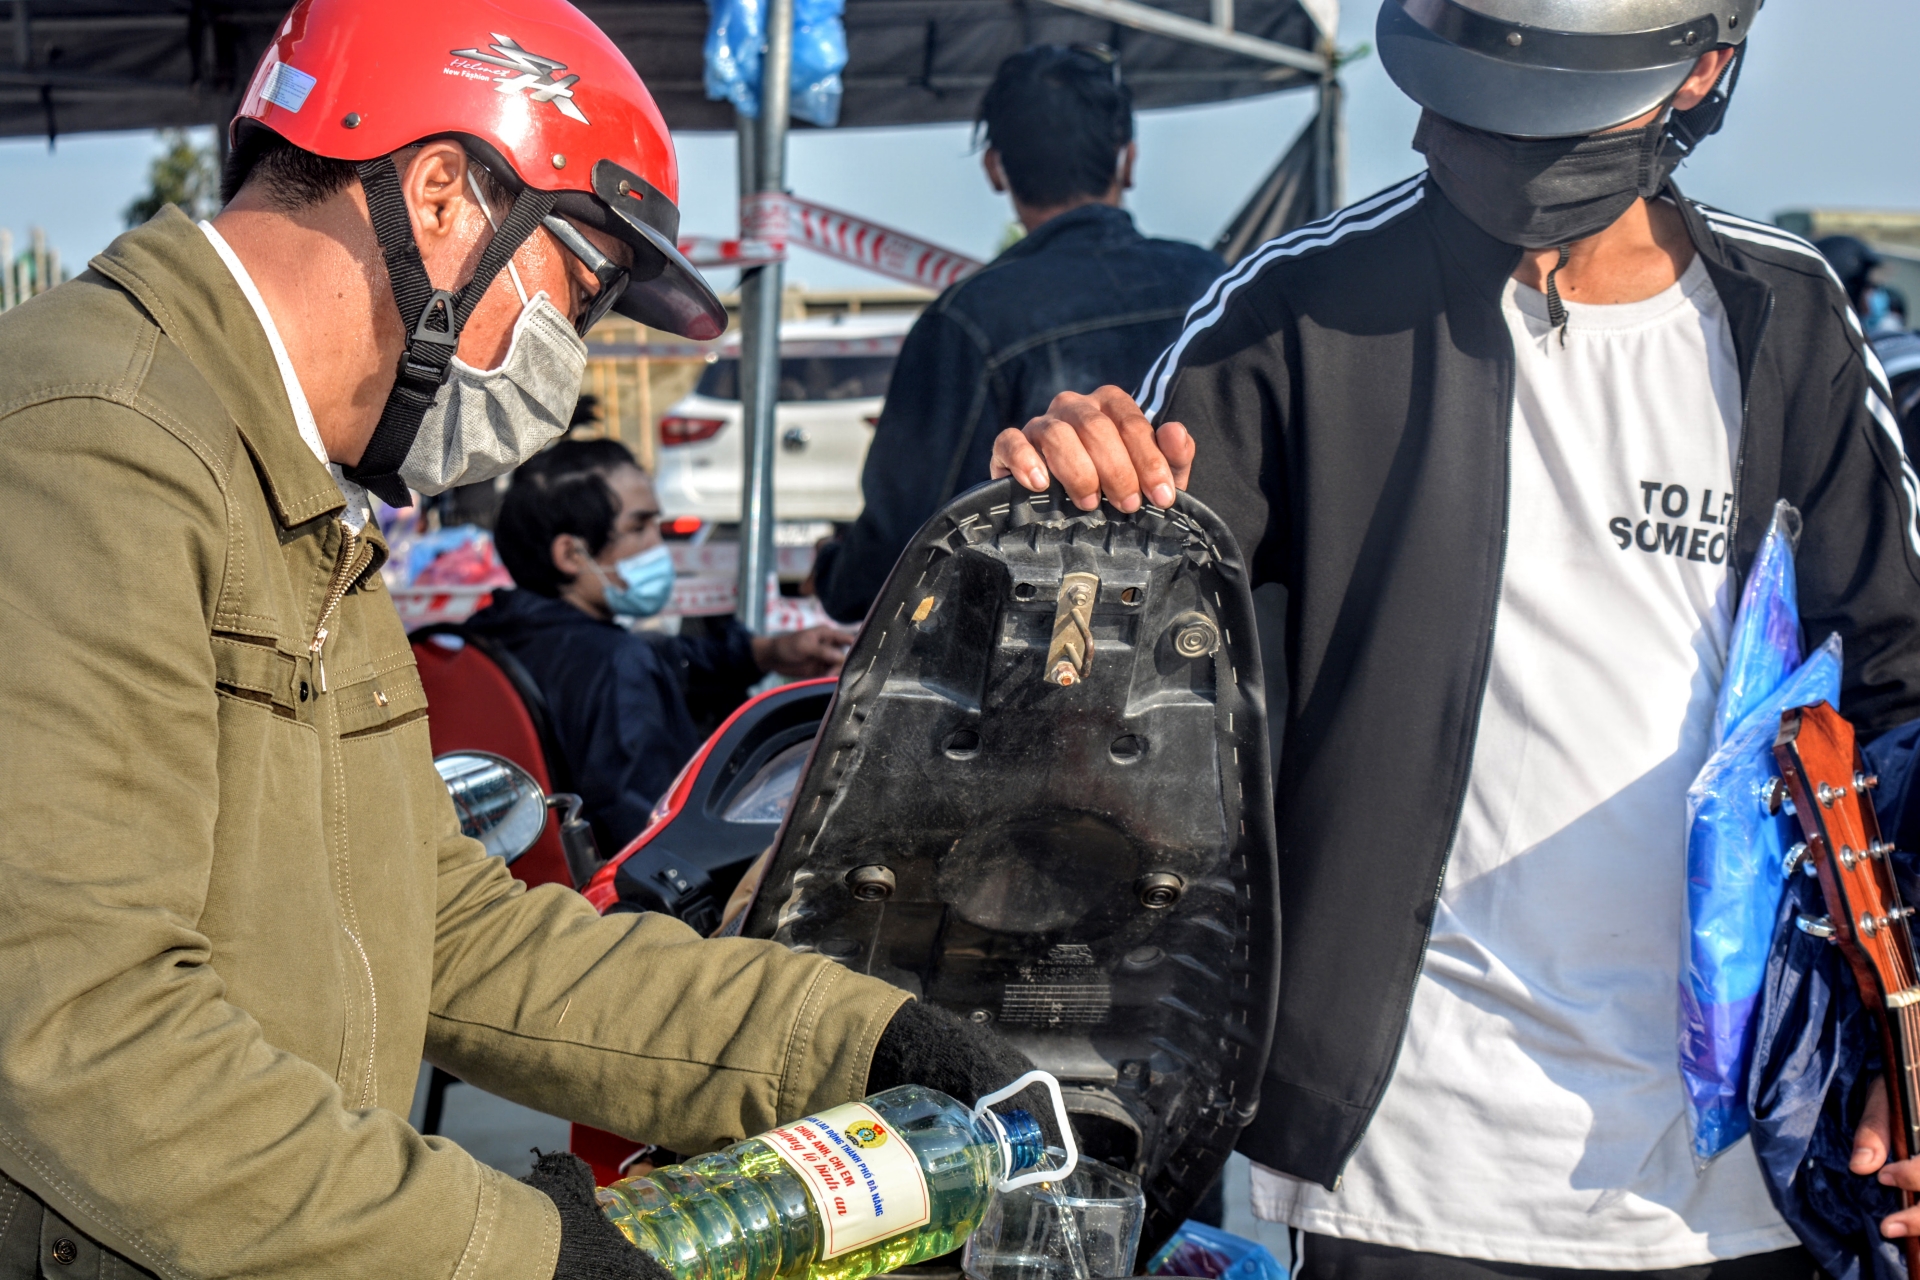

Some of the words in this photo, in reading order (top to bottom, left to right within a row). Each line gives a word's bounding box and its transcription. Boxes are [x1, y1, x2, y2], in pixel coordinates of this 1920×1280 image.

[443, 67, 460, 76] New
[461, 70, 490, 81] Fashion
[450, 59, 510, 77] Helmet
[1640, 480, 1689, 518] TO
[815, 1121, 830, 1130] LAO
[825, 1129, 844, 1145] ĐỘNG
[794, 1125, 817, 1141] CHÚC
[811, 1141, 832, 1157] ANH,
[828, 1156, 846, 1171] CHỊ
[840, 1170, 856, 1187] EM
[841, 1144, 863, 1163] THÀNH
[858, 1163, 875, 1179] PHỐ
[813, 1164, 840, 1192] bình
[834, 1196, 847, 1217] an
[866, 1180, 878, 1192] ĐÀ
